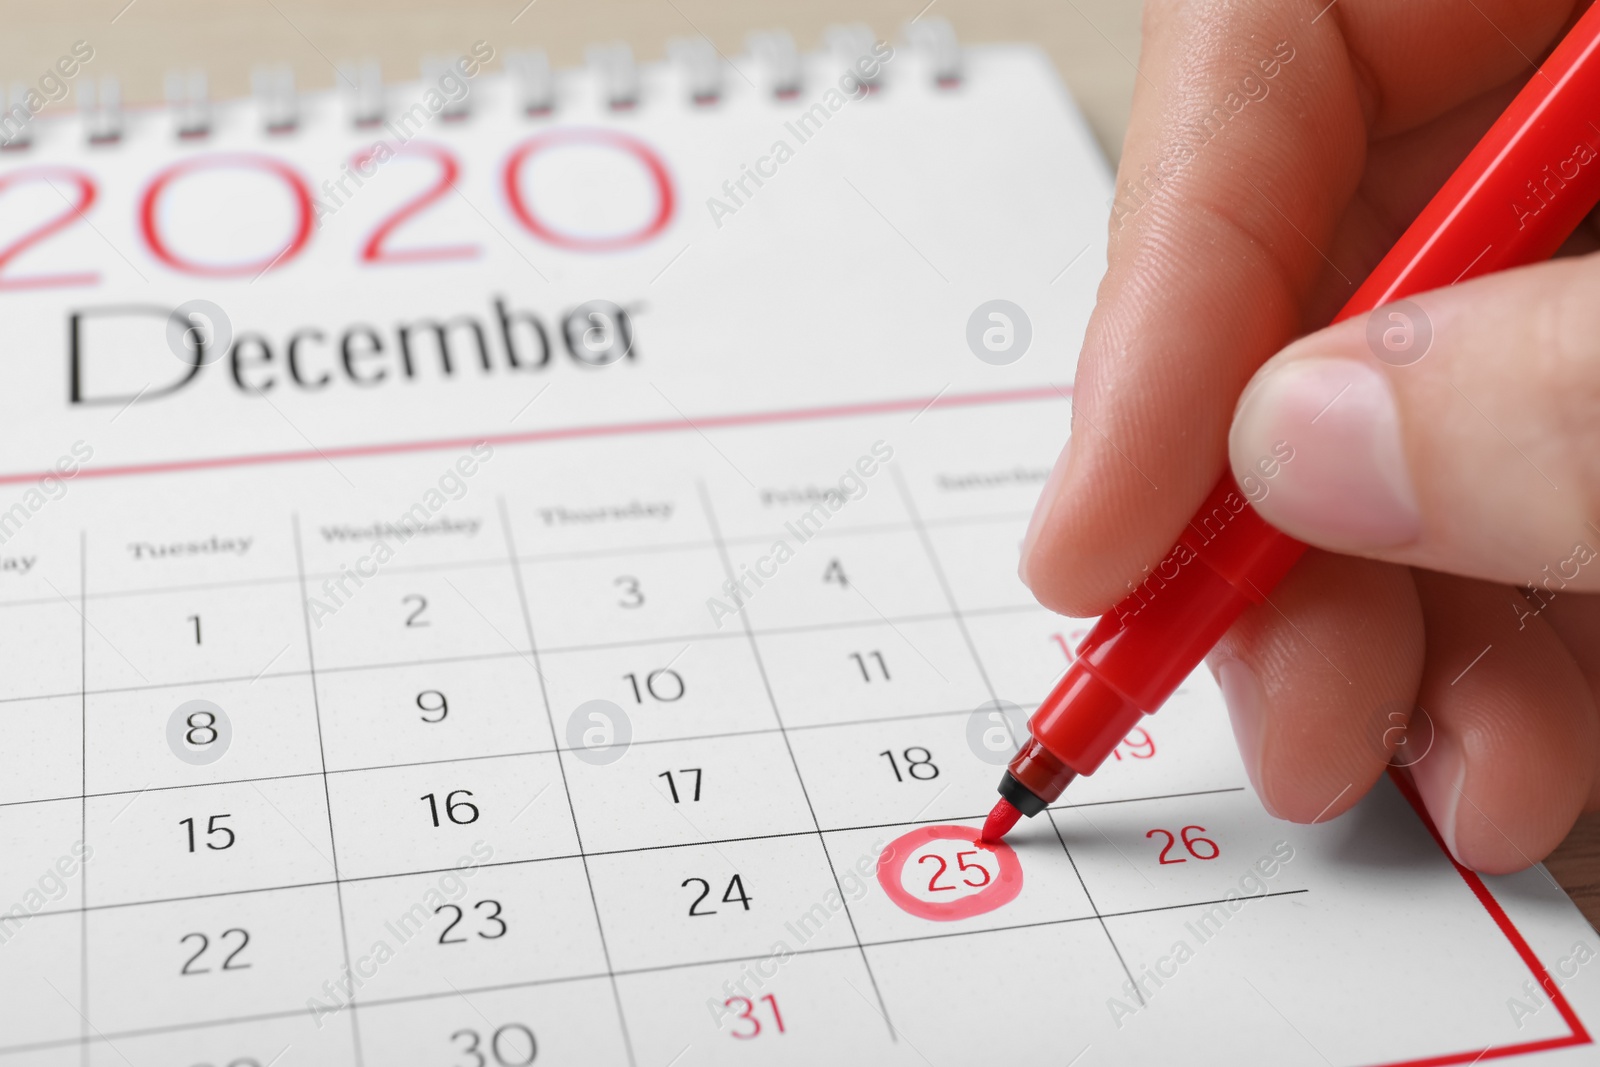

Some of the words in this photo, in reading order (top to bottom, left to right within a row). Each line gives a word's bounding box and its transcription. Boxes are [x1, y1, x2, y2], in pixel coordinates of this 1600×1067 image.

[0, 128, 674, 290] 2020
[68, 292, 645, 404] December
[127, 535, 253, 561] Tuesday
[402, 593, 431, 628] 2
[612, 574, 645, 609] 3
[186, 613, 202, 645] 1
[849, 649, 892, 683] 11
[622, 668, 685, 704] 10
[415, 689, 448, 723] 9
[186, 711, 218, 745] 8
[879, 746, 940, 782] 18
[658, 768, 703, 805] 17
[420, 789, 480, 827] 16
[179, 813, 236, 853] 15
[1146, 825, 1221, 865] 26
[918, 850, 991, 892] 25
[681, 873, 753, 917] 24
[433, 899, 508, 944] 23
[178, 928, 253, 976] 22
[723, 992, 789, 1041] 31
[449, 1022, 539, 1067] 30
